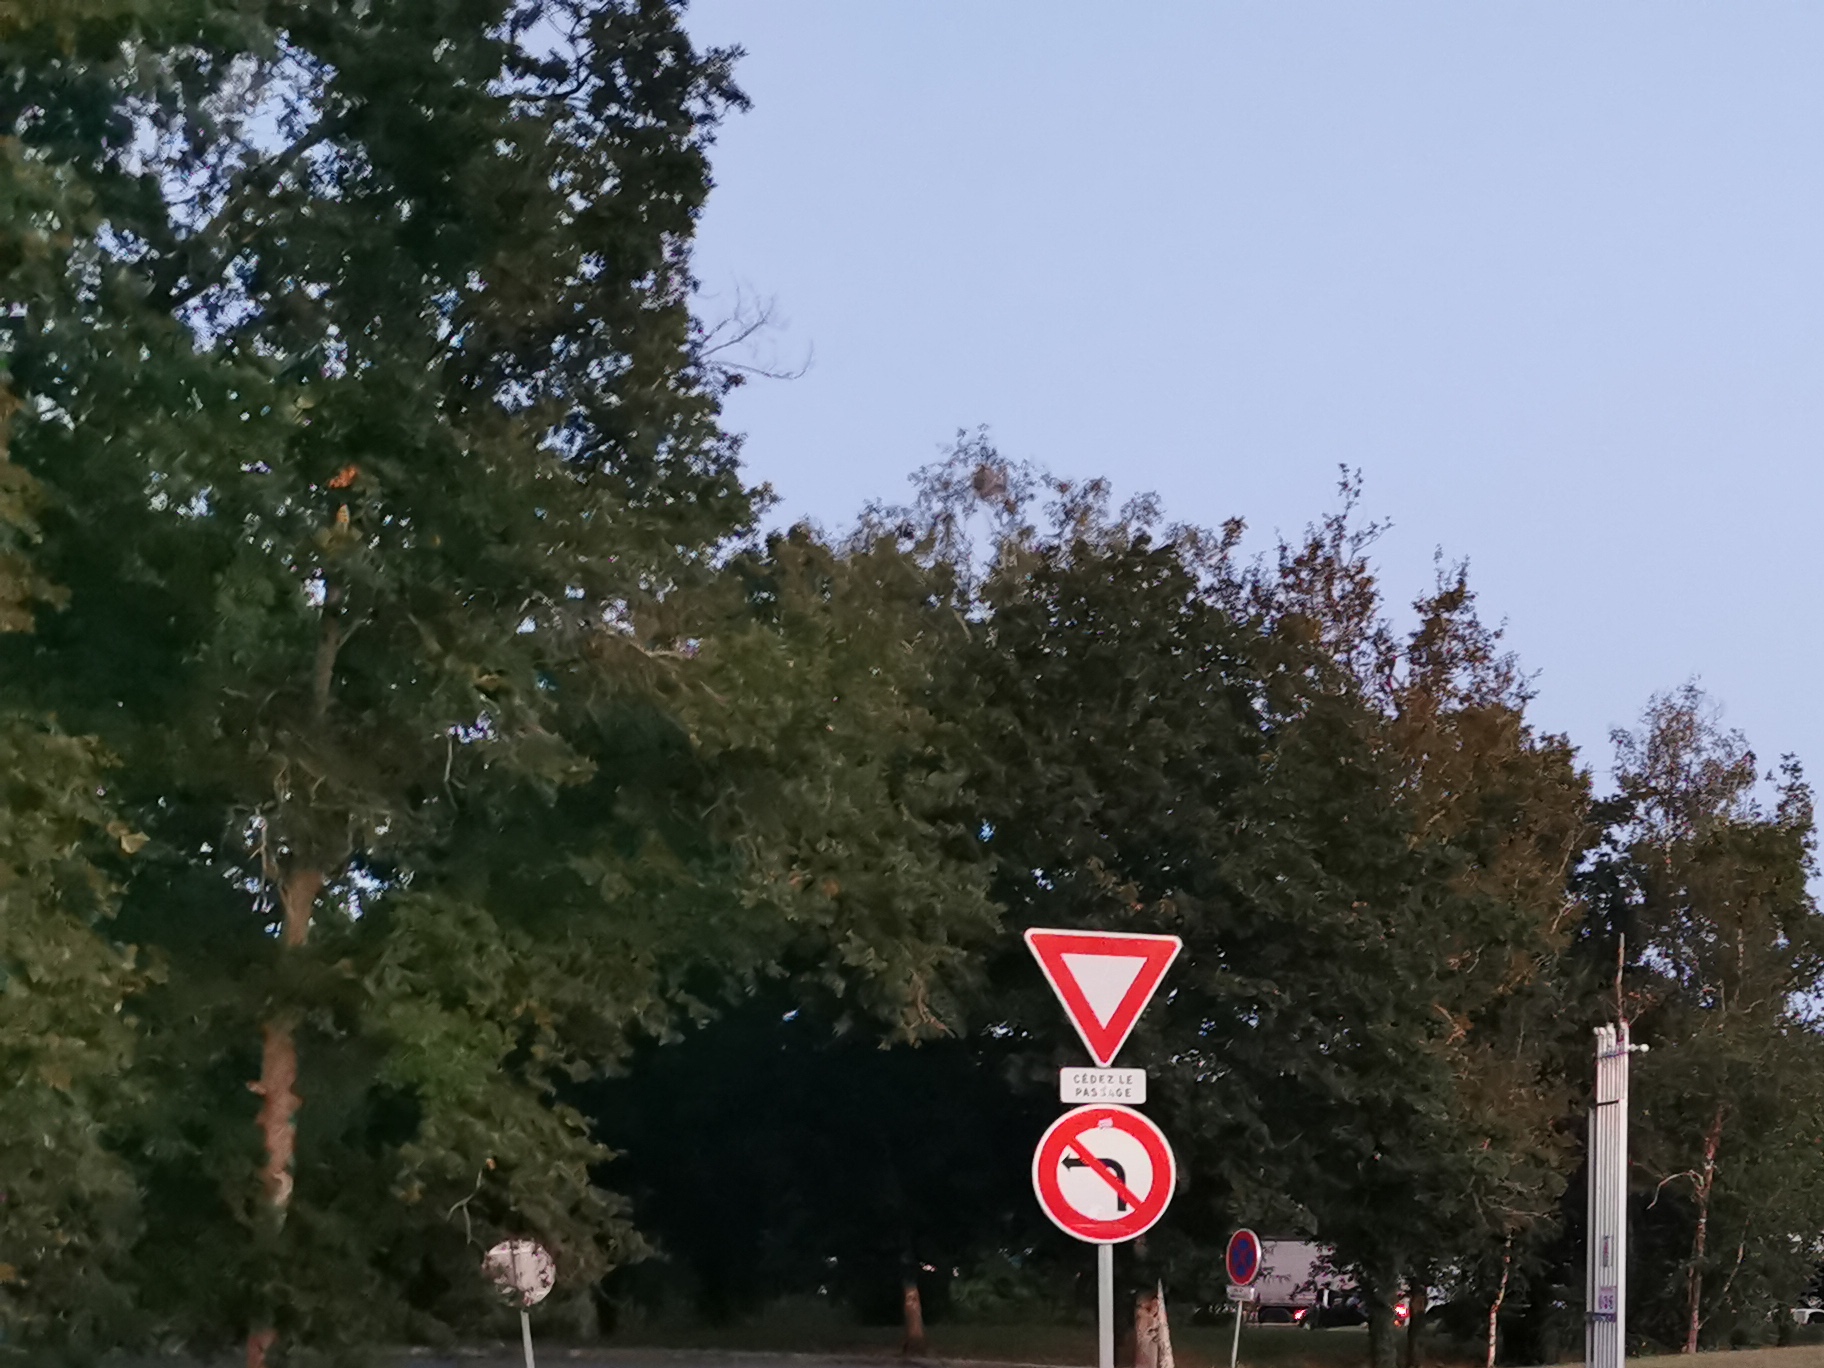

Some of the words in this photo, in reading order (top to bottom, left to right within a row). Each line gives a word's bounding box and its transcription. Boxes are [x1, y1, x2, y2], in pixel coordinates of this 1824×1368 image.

[1073, 1073, 1114, 1085] CÉDEZ
[1119, 1075, 1133, 1085] LE
[1075, 1087, 1132, 1098] PASSAGE
